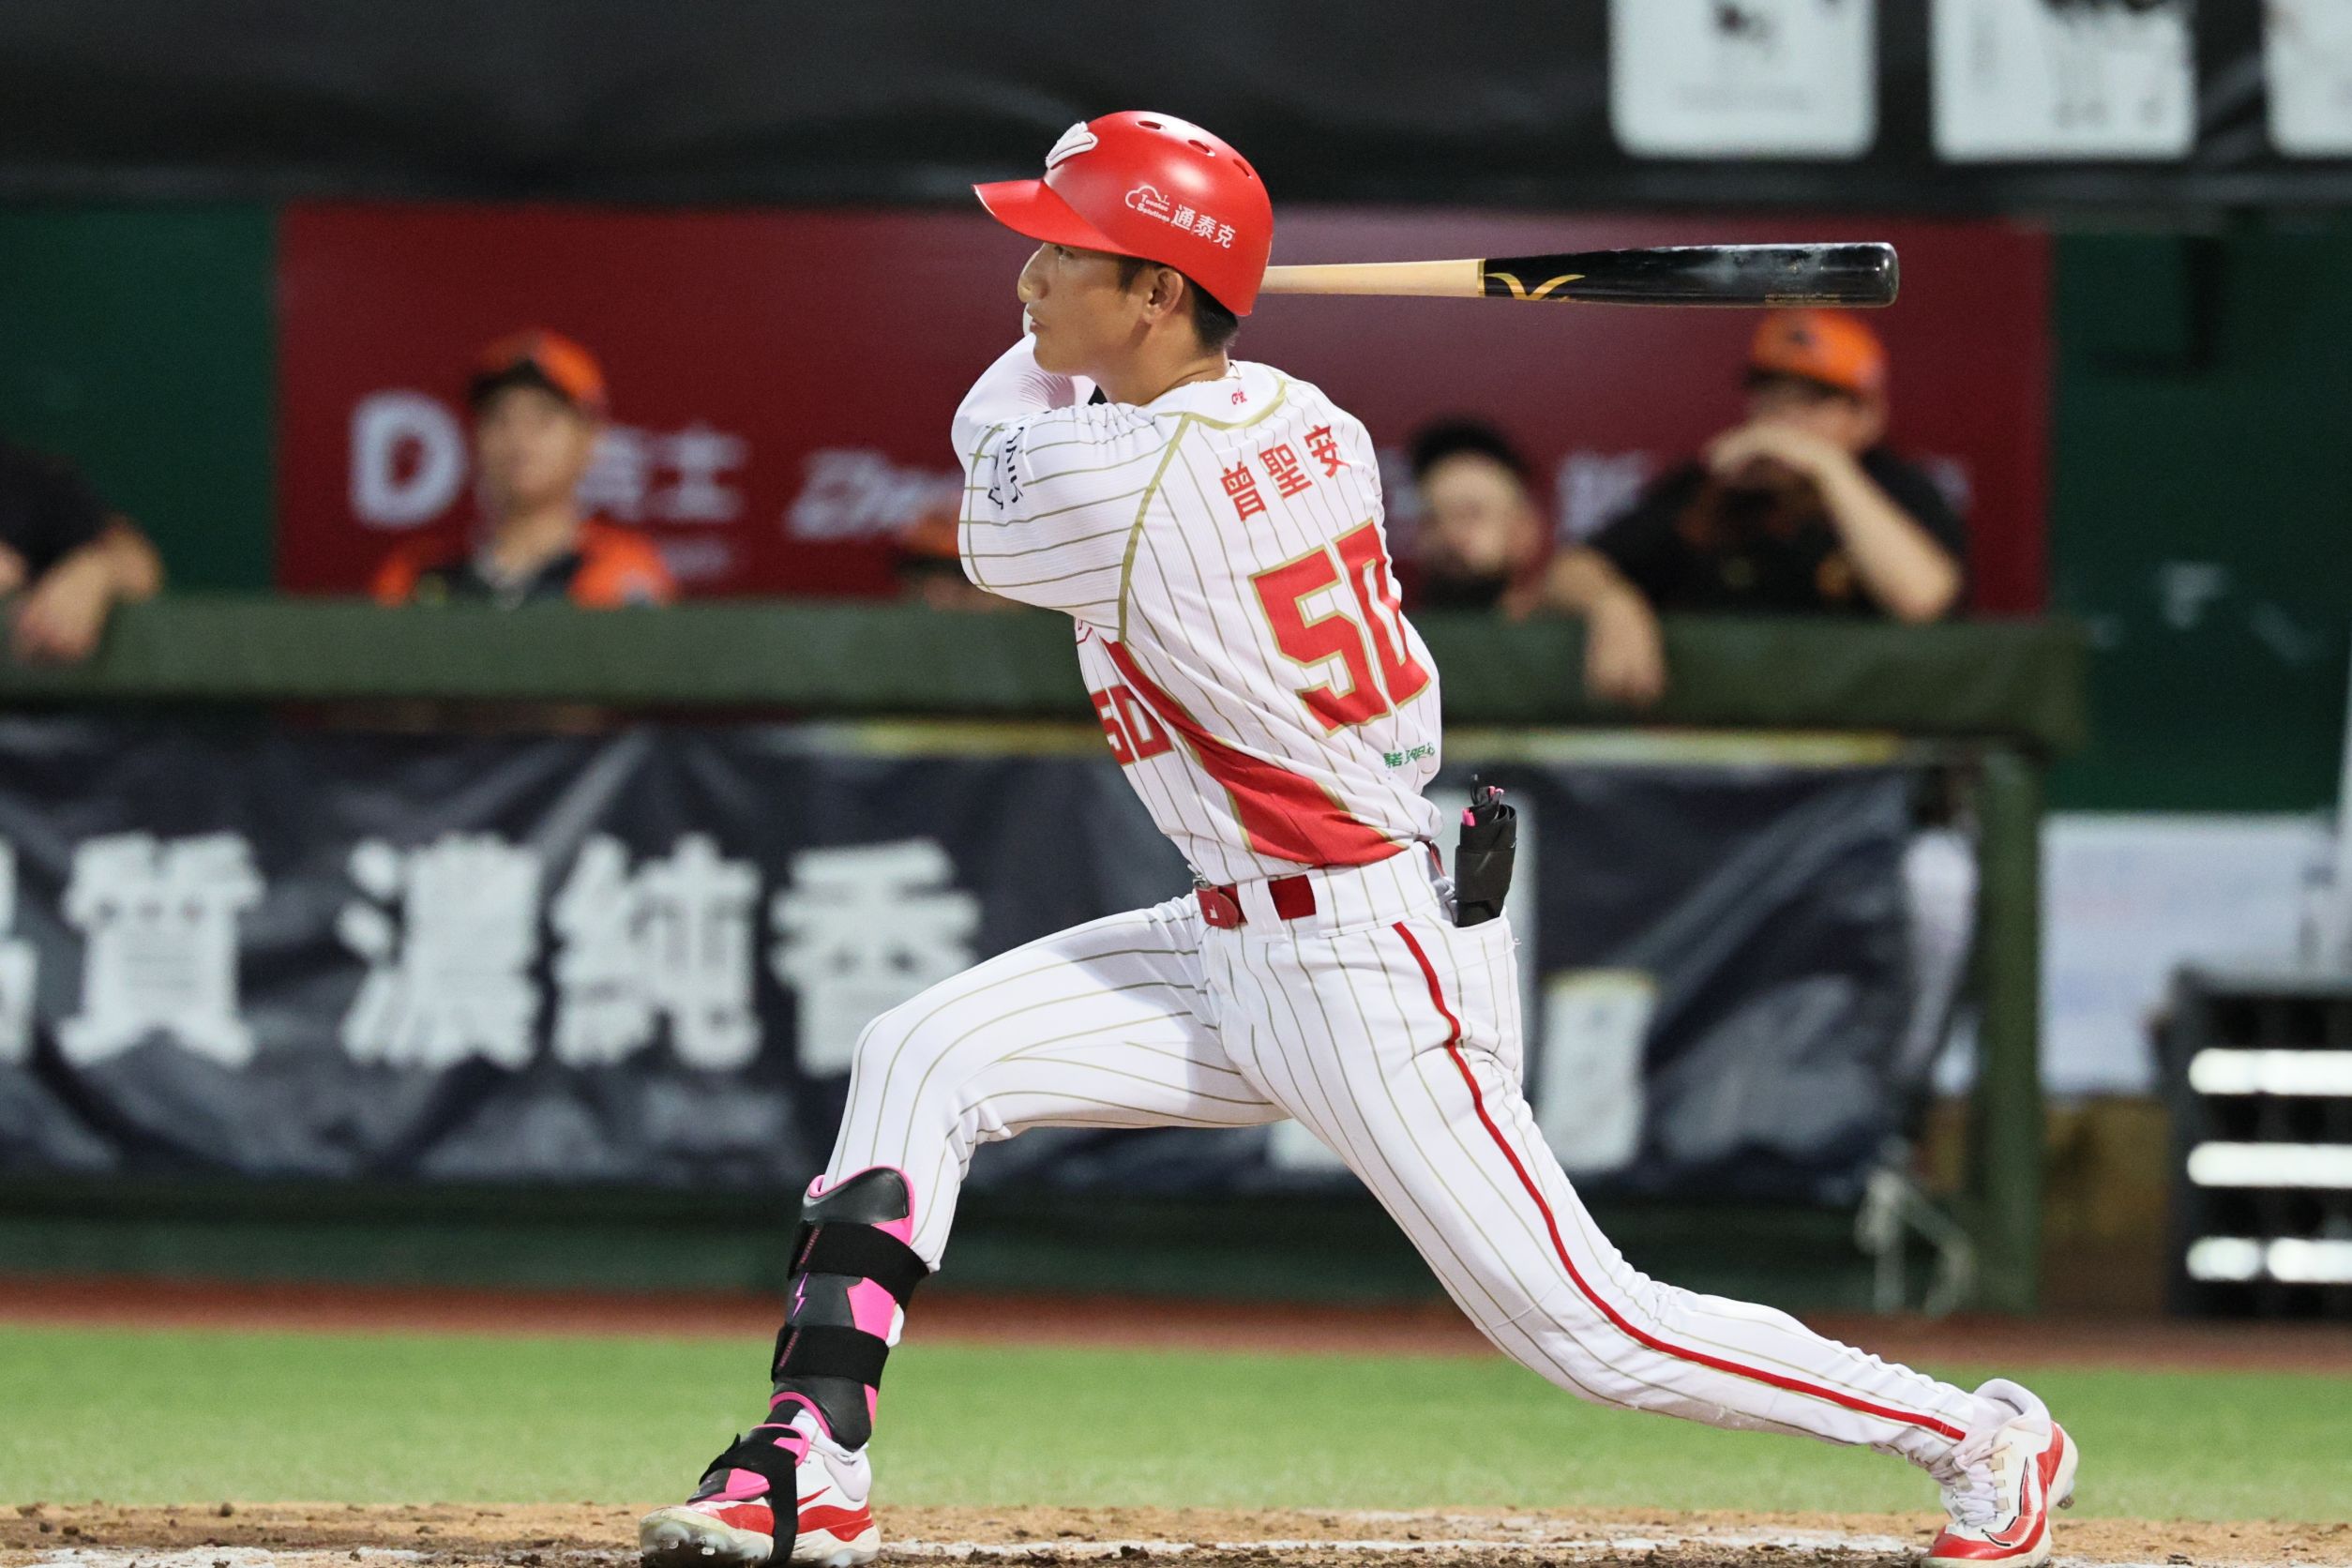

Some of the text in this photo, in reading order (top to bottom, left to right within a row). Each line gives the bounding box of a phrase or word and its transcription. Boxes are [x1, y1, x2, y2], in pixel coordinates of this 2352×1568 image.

[1171, 204, 1236, 249] 通泰克
[1220, 424, 1351, 522] 曾聖安
[1247, 517, 1433, 738] 50
[1089, 684, 1176, 767] 50
[0, 831, 981, 1076] 質 濃純香
